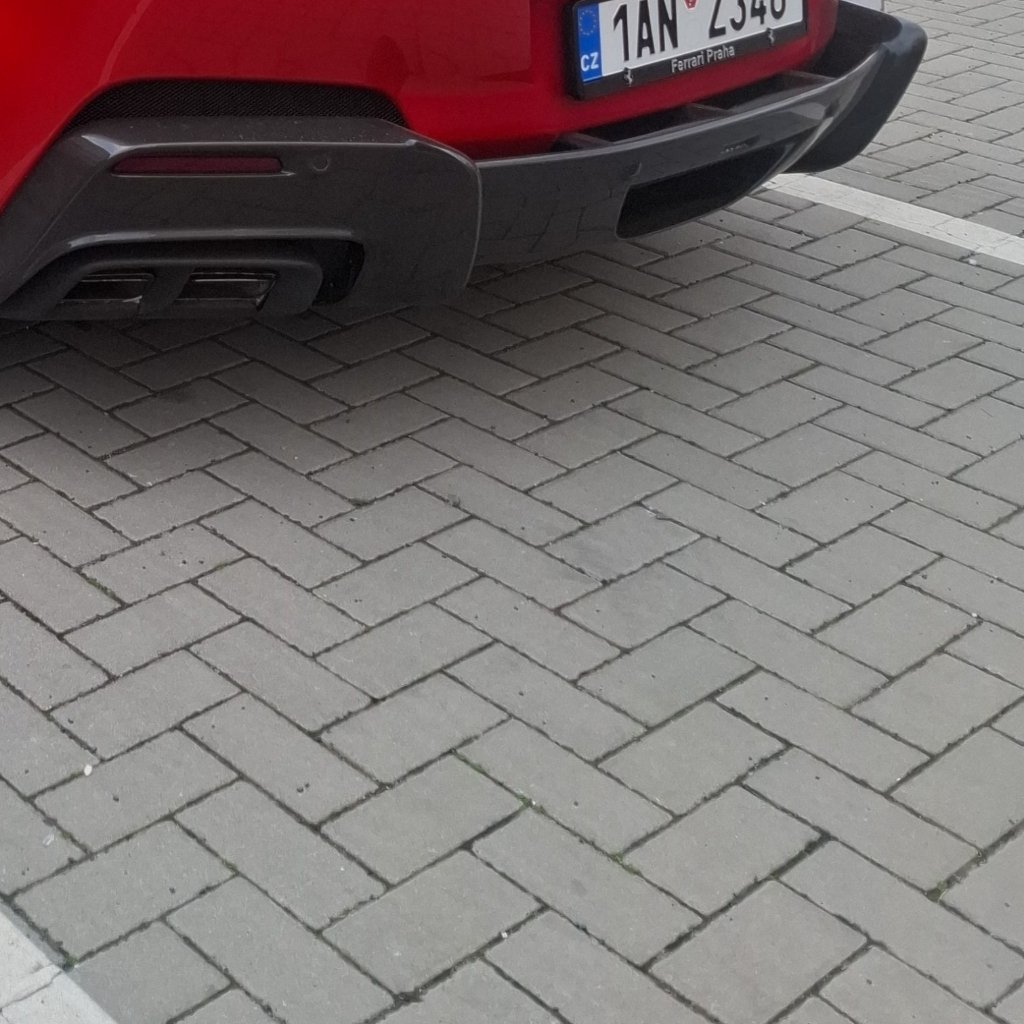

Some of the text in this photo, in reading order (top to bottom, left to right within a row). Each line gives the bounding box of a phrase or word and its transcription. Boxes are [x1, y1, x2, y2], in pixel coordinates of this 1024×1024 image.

[580, 54, 599, 72] CZ
[671, 44, 736, 73] Ferrari Praha
